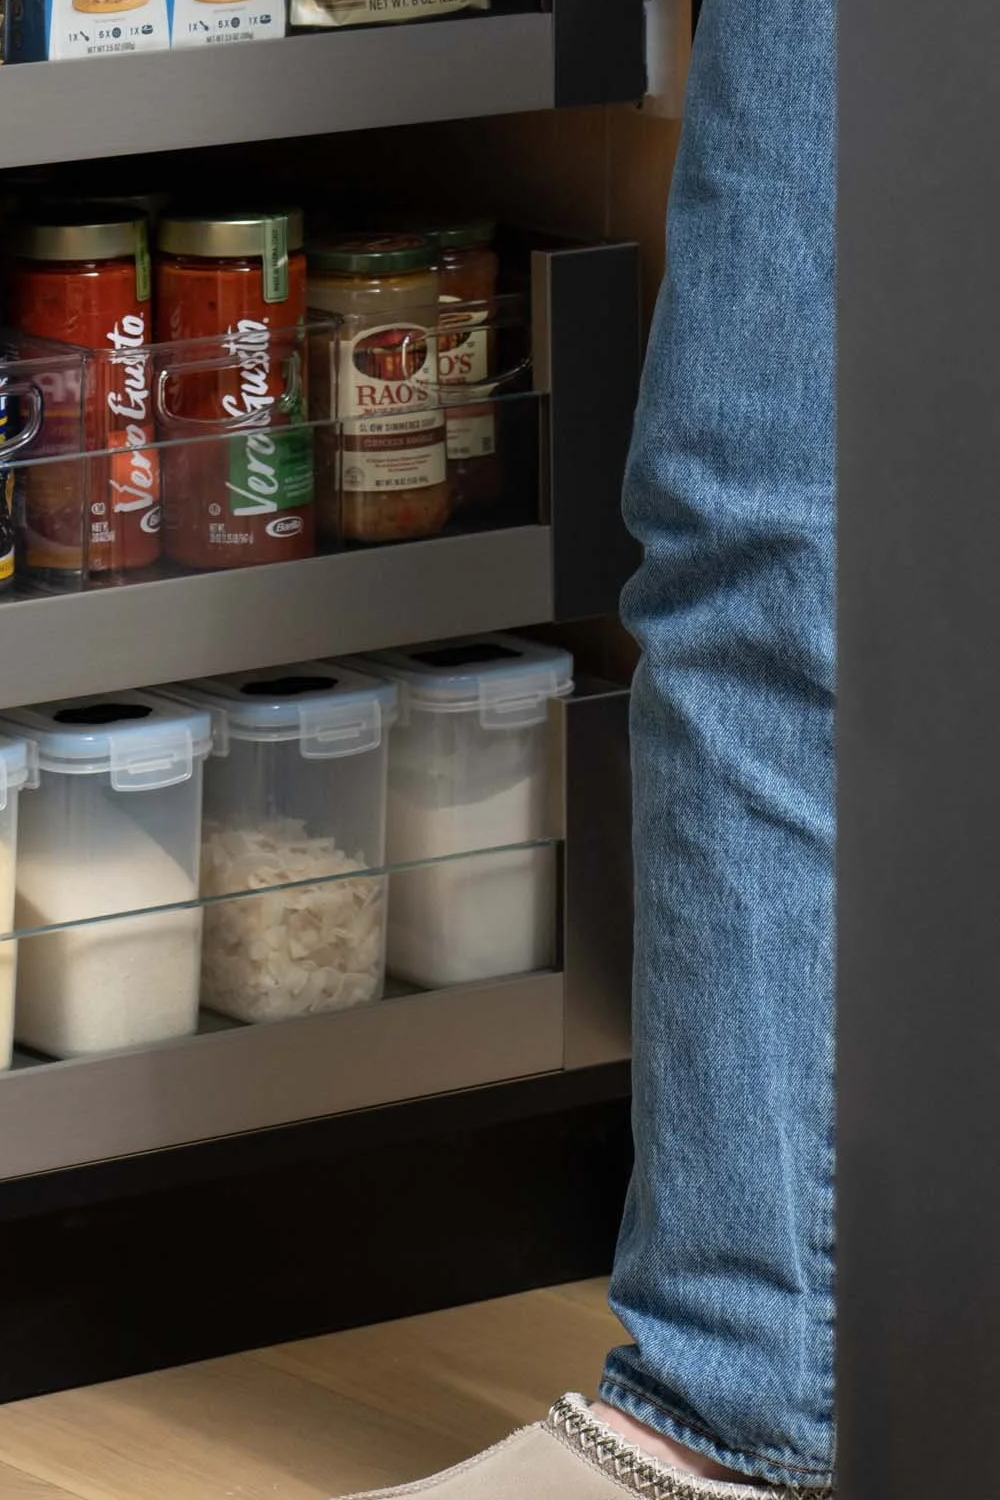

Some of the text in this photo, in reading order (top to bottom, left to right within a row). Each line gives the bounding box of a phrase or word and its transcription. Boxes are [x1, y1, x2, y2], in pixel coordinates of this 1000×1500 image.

[221, 319, 275, 427] Gusto
[439, 352, 474, 377] O'S
[106, 313, 154, 513] Vero Gusto
[355, 382, 429, 407] RAO'S
[359, 421, 383, 433] SLOW
[225, 428, 279, 516] Vero
